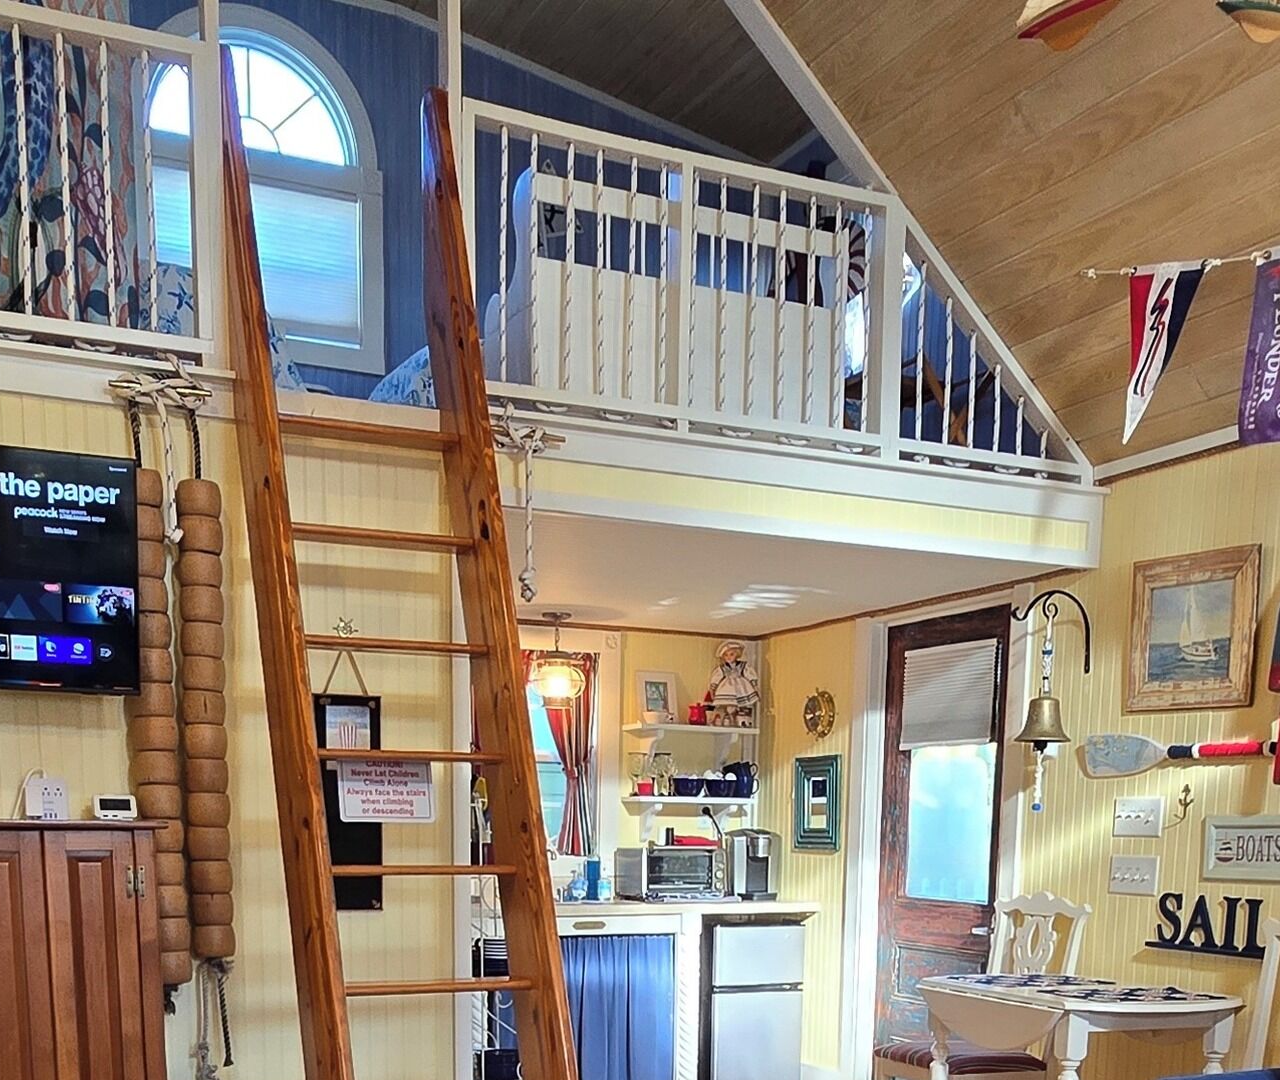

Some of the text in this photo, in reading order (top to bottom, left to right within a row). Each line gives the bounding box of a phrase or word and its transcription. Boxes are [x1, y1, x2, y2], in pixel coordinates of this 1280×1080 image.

[47, 481, 120, 507] paper
[14, 506, 58, 519] peacock
[351, 768, 419, 778] Never Let Children
[387, 779, 408, 787] Alone
[346, 787, 426, 797] Always face the stairs
[382, 798, 414, 807] climbing
[372, 807, 414, 816] descending
